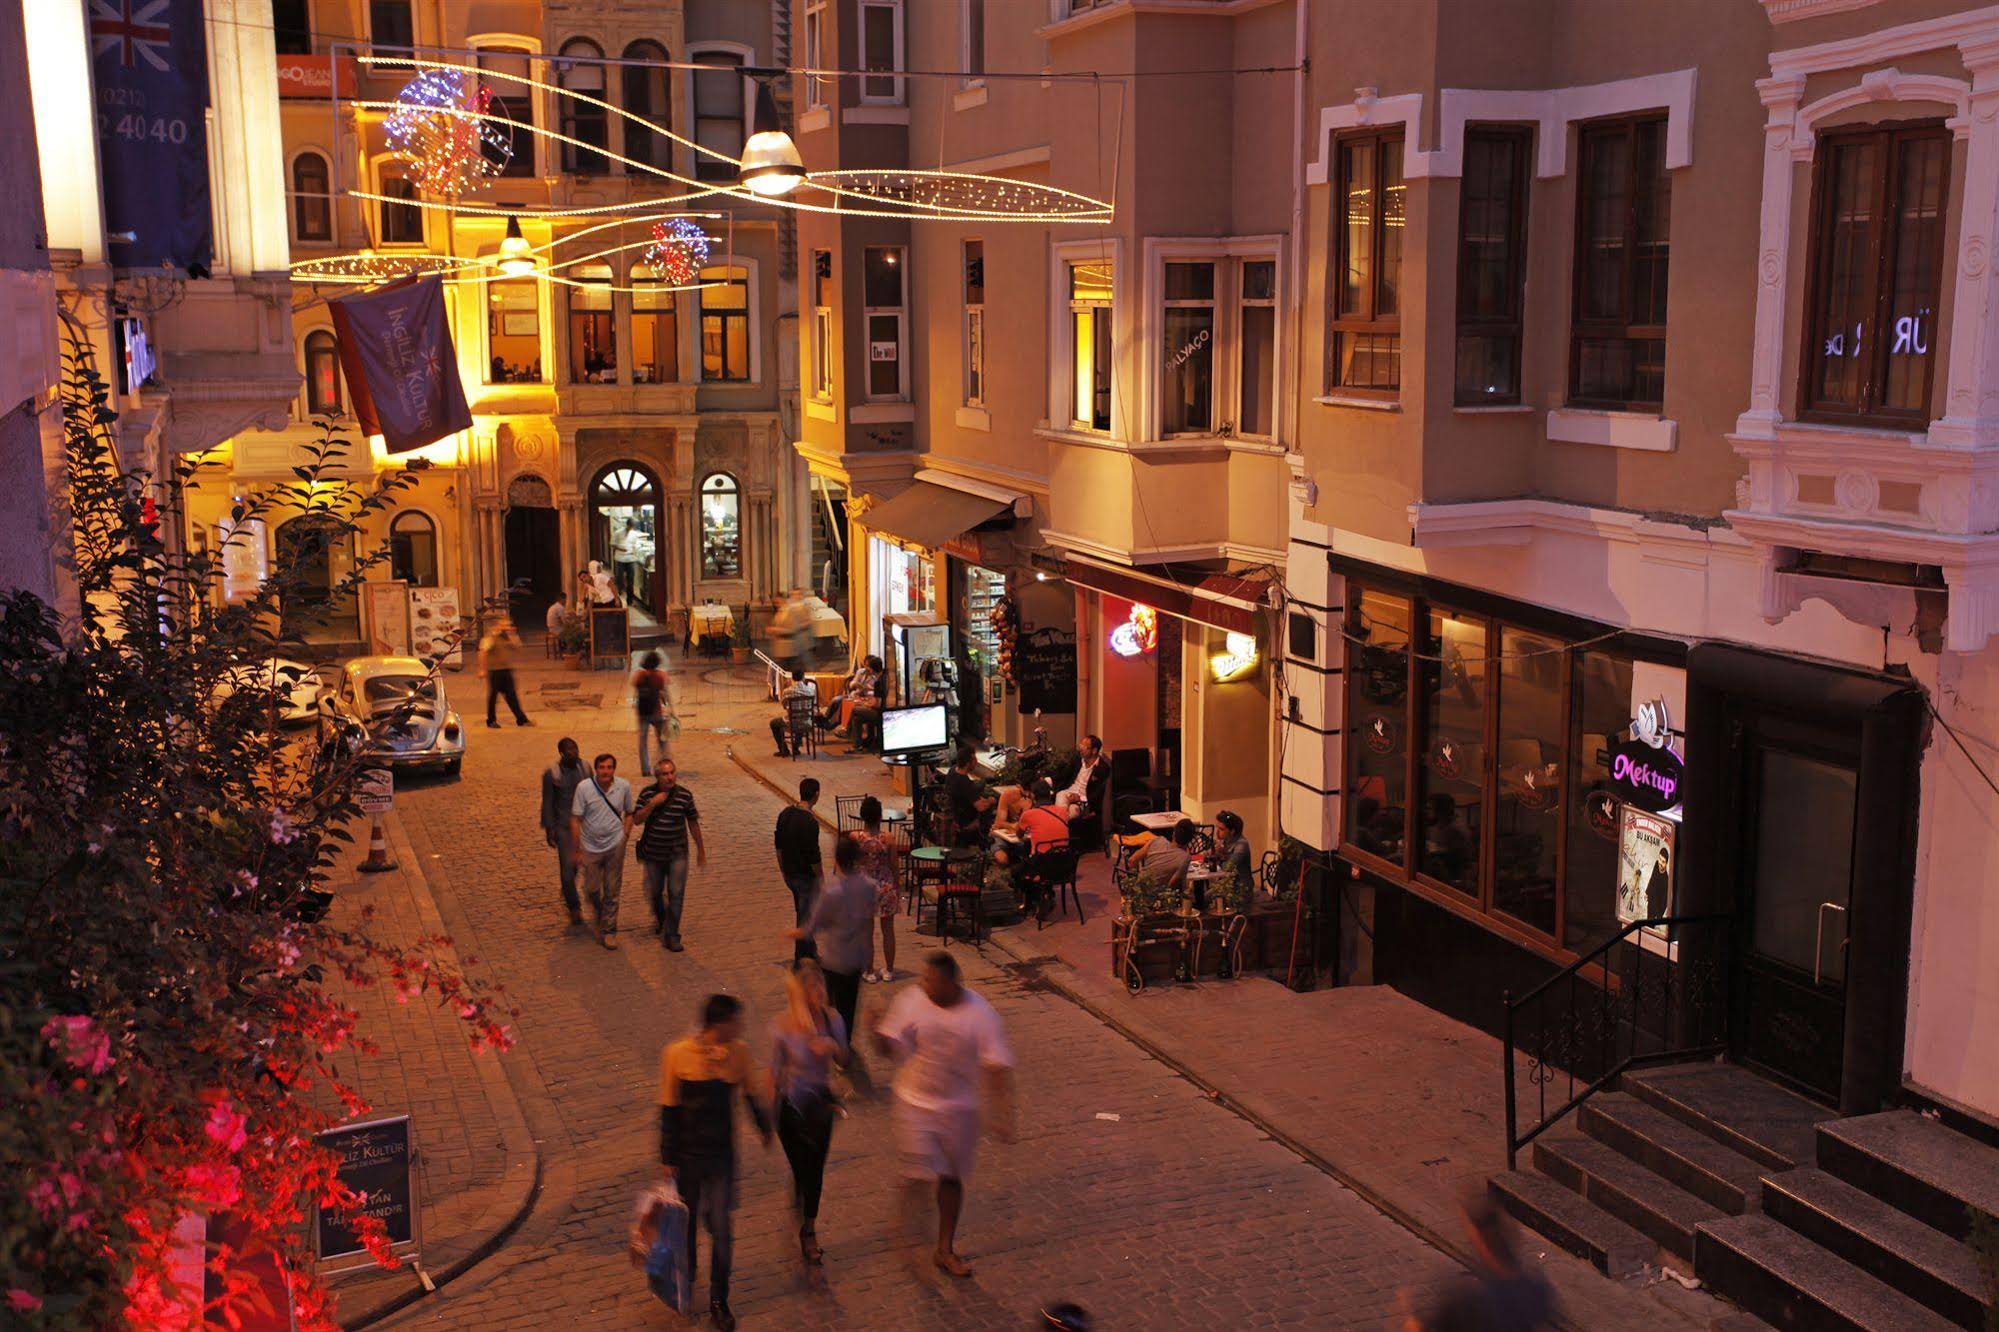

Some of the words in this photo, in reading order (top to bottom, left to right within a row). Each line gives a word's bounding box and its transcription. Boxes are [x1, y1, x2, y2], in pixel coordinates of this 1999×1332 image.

[116, 113, 146, 140] 40
[149, 117, 187, 144] 40
[1614, 753, 1676, 800] Mektup
